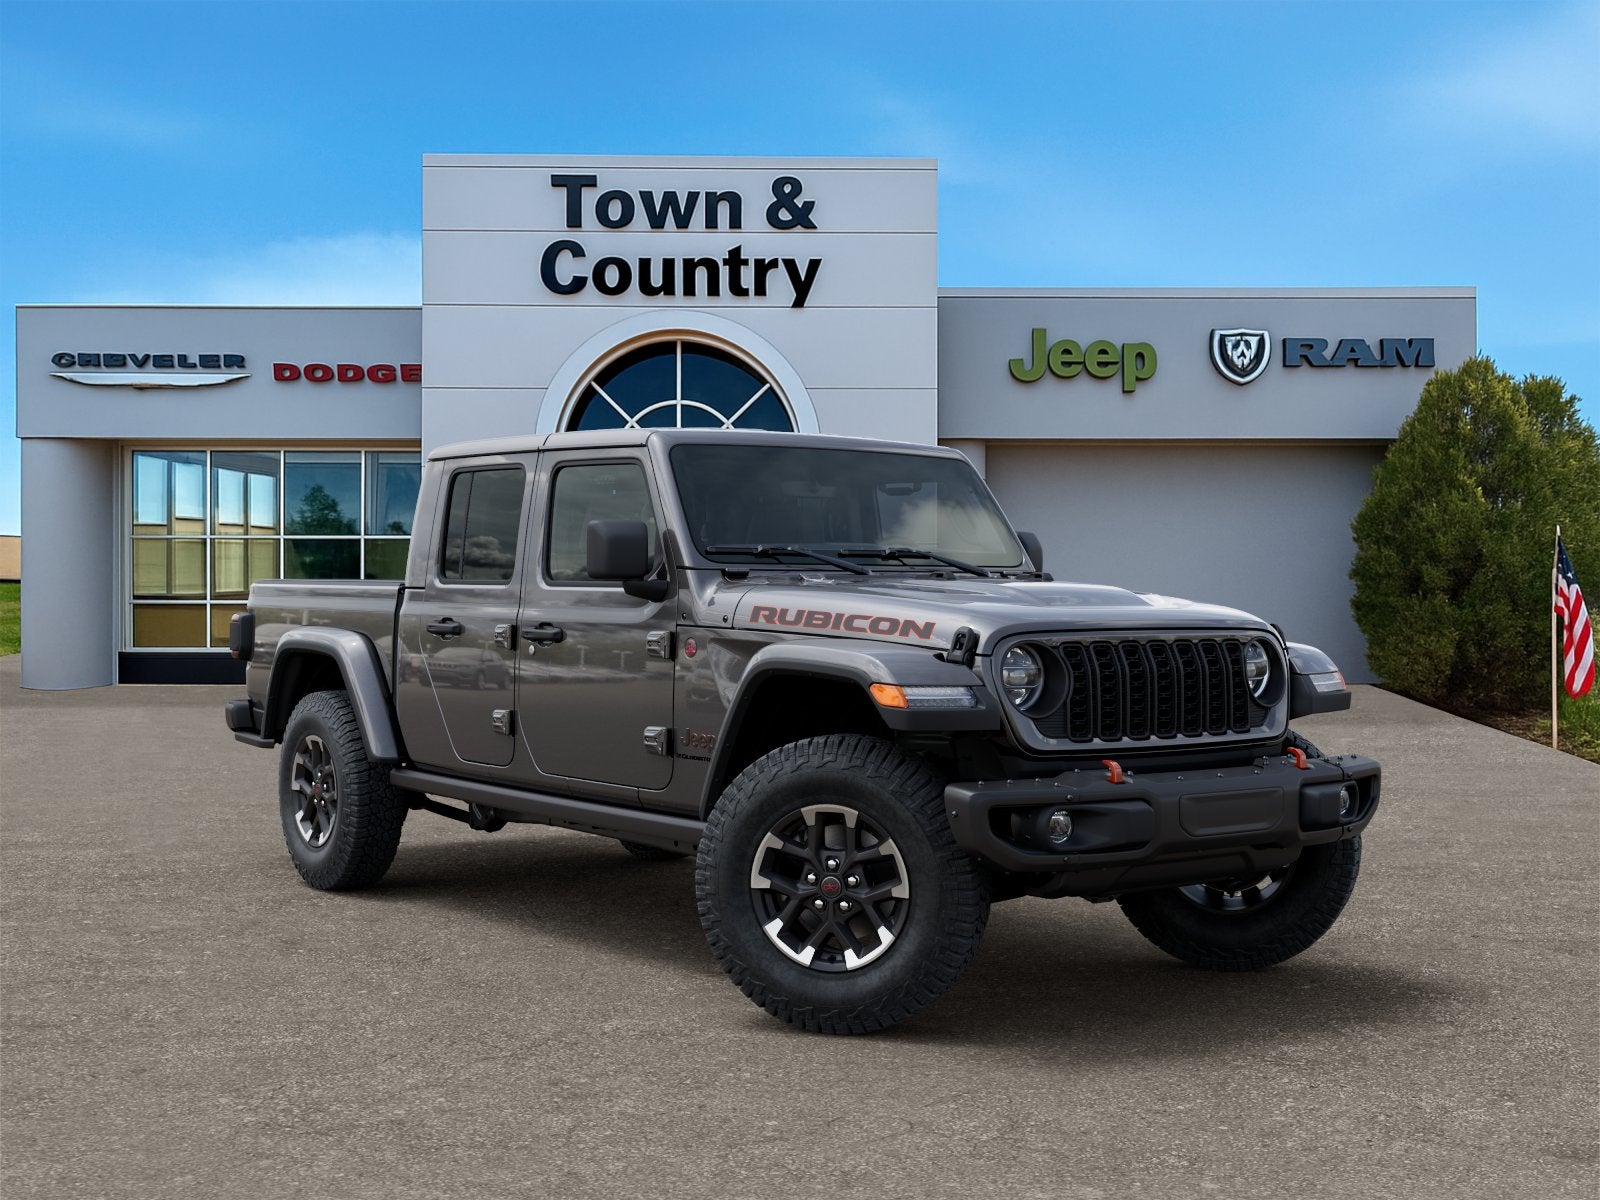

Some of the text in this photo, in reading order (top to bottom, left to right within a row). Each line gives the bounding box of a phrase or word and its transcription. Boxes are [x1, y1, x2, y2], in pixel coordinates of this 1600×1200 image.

[550, 174, 818, 230] Town &
[540, 239, 823, 308] Country
[1008, 328, 1157, 393] Jeep
[1282, 337, 1436, 367] RAM
[273, 362, 422, 383] DODGE
[750, 605, 936, 640] RUBICON
[680, 727, 716, 752] Jeep
